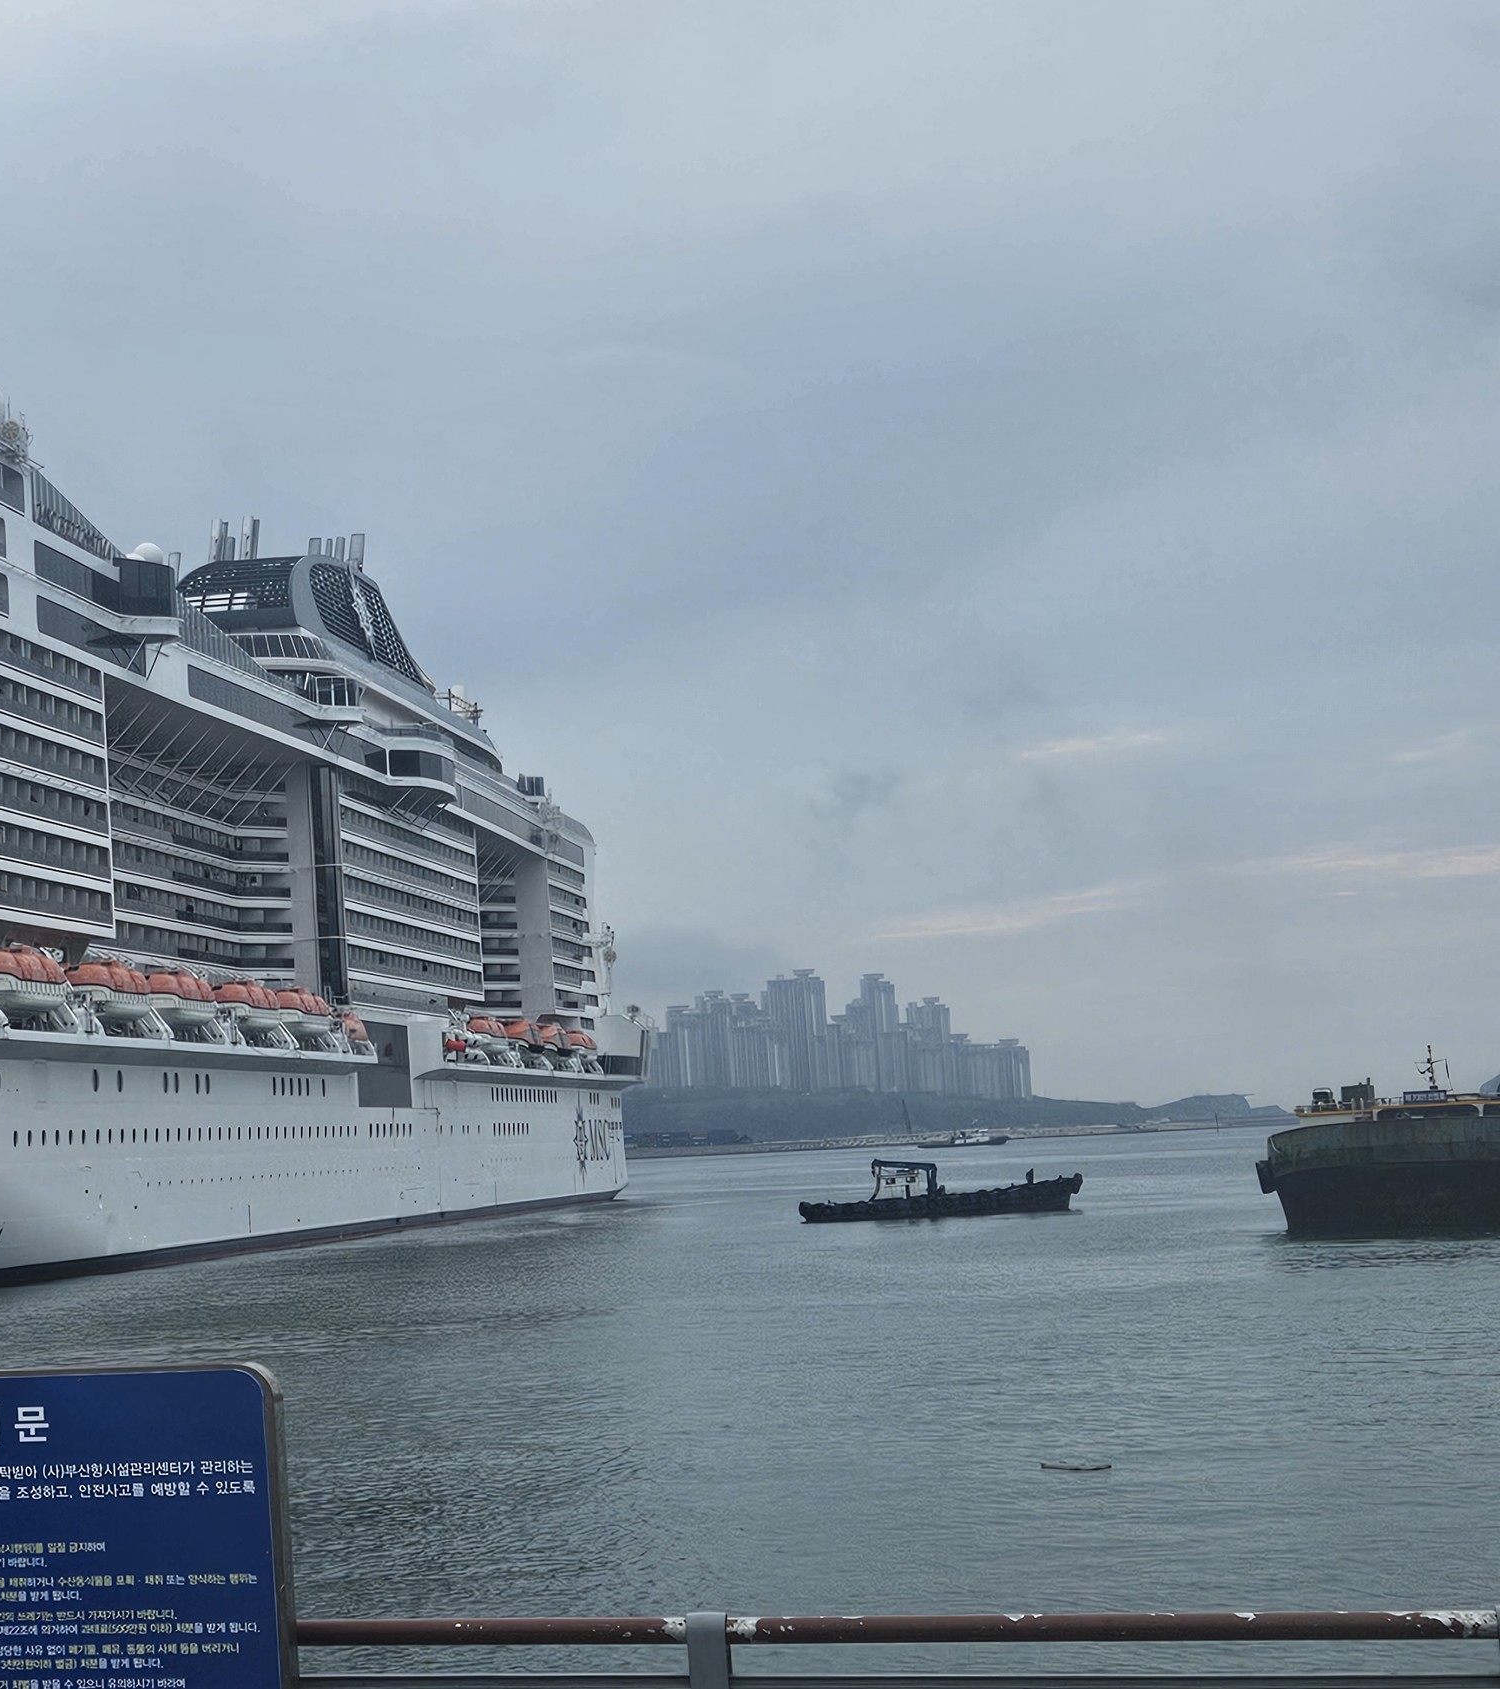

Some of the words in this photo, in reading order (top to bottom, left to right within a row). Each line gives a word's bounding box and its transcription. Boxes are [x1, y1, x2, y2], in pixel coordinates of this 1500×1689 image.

[201, 1460, 253, 1474] 관리하는
[79, 1483, 144, 1498] 안전사고를
[151, 1482, 190, 1496] 예방할
[196, 1481, 209, 1495] 수
[216, 1480, 255, 1494] 있도록
